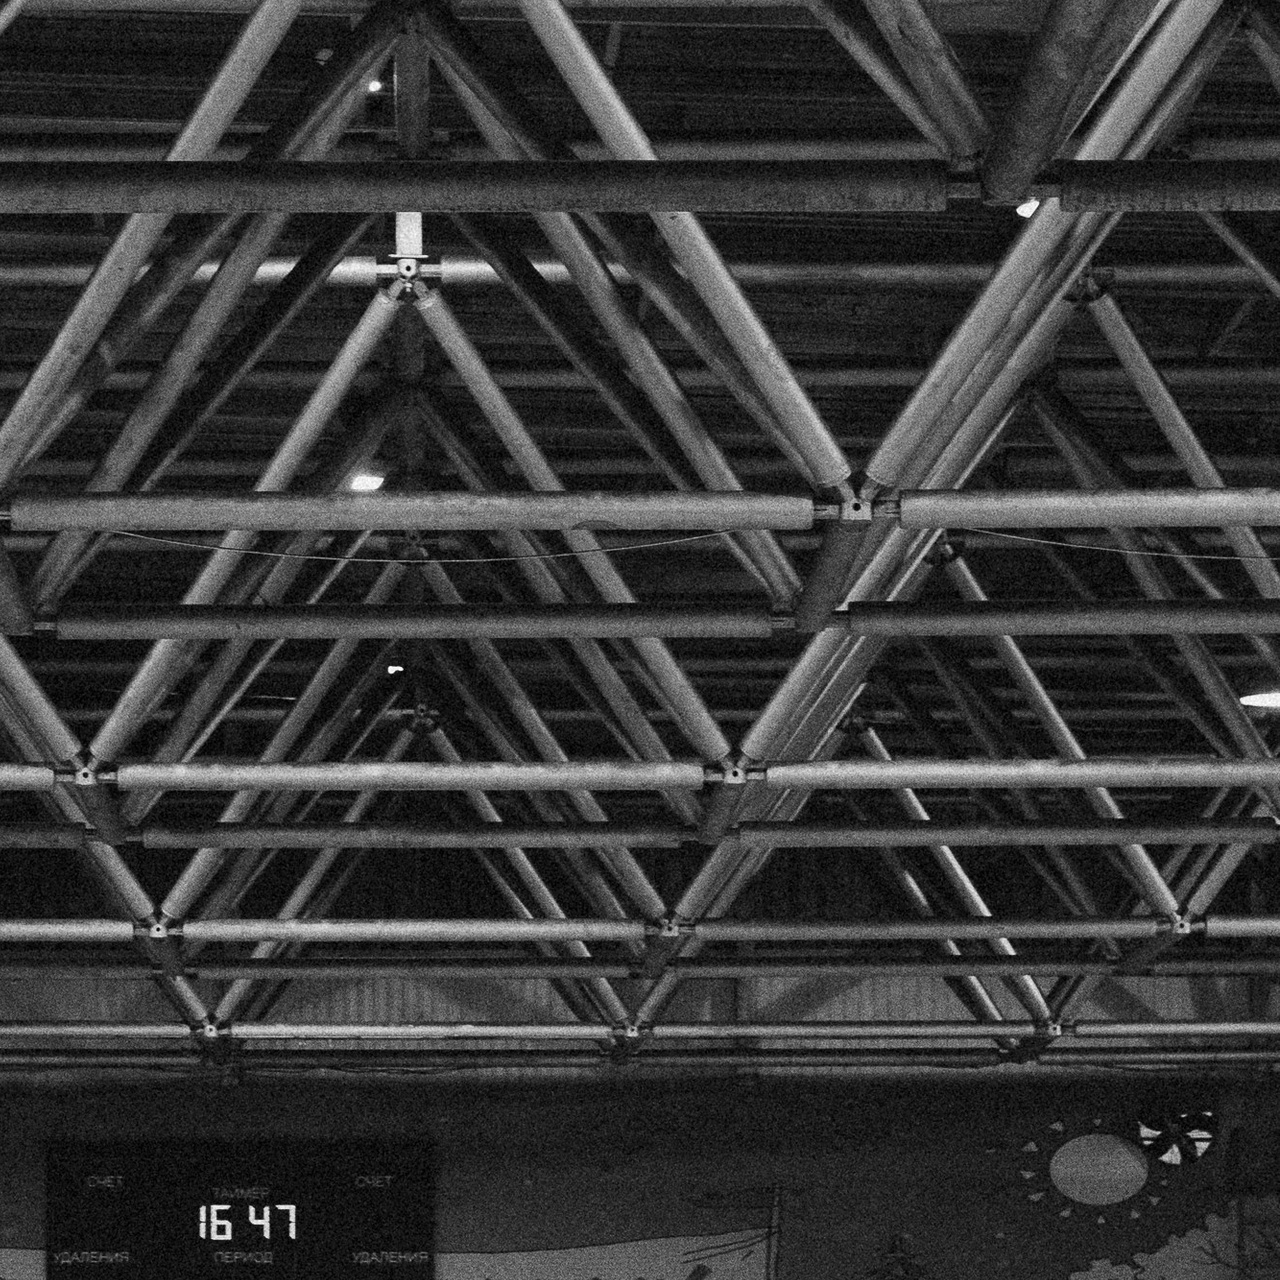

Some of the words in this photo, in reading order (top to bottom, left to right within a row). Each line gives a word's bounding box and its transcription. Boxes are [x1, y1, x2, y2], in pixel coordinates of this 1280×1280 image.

[199, 1205, 232, 1240] 16
[249, 1205, 296, 1240] 47
[53, 1250, 129, 1265] УДАЛЕНИЯ
[213, 1251, 274, 1265] ПЕРИОД
[352, 1250, 429, 1265] УДАЛЕНИЯ
